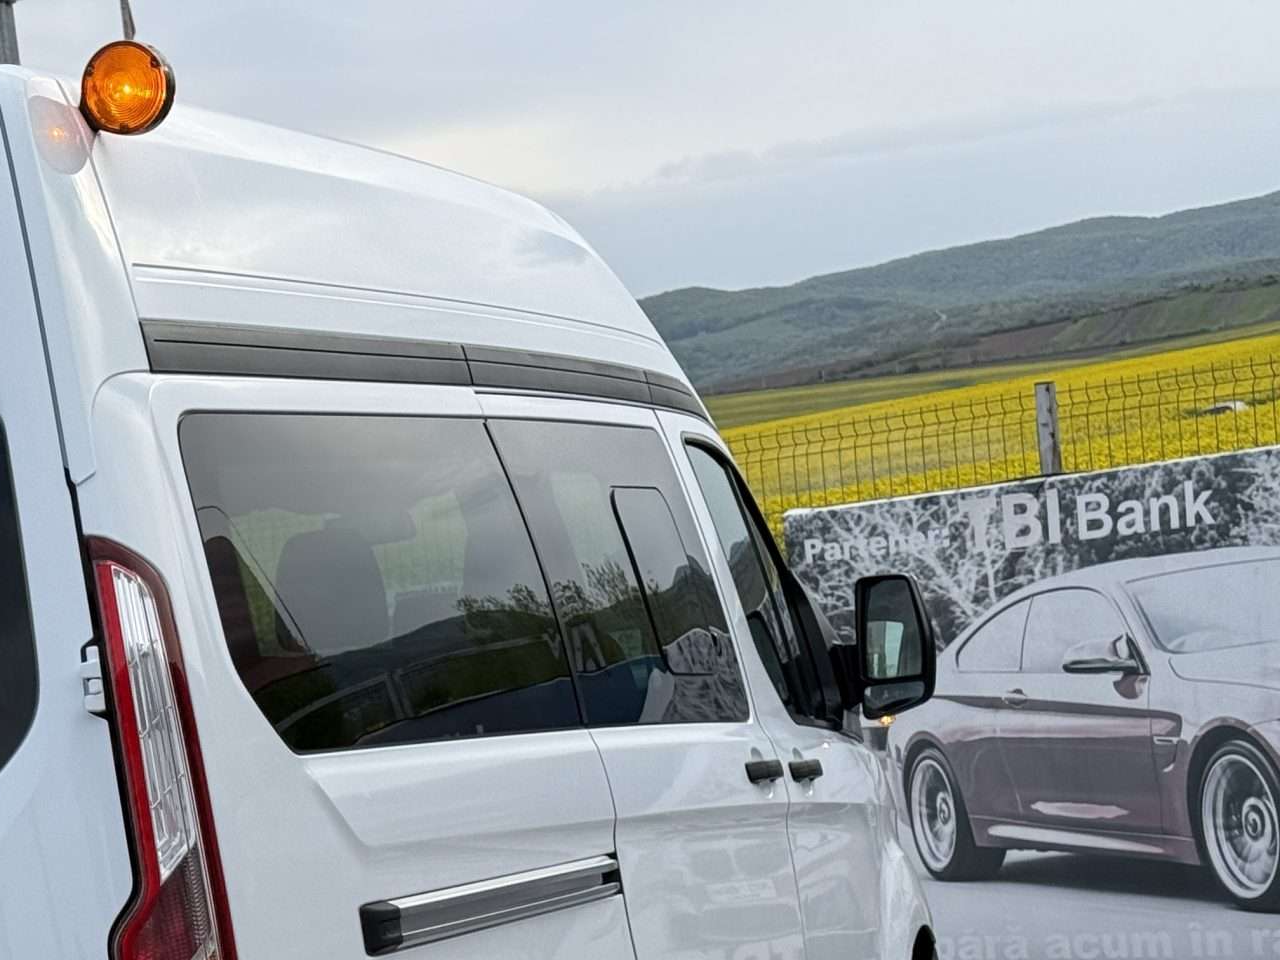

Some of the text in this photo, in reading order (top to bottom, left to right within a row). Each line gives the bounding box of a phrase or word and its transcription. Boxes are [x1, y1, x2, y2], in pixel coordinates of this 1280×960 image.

[960, 480, 1216, 551] TBI Bank
[1047, 930, 1175, 960] acum
